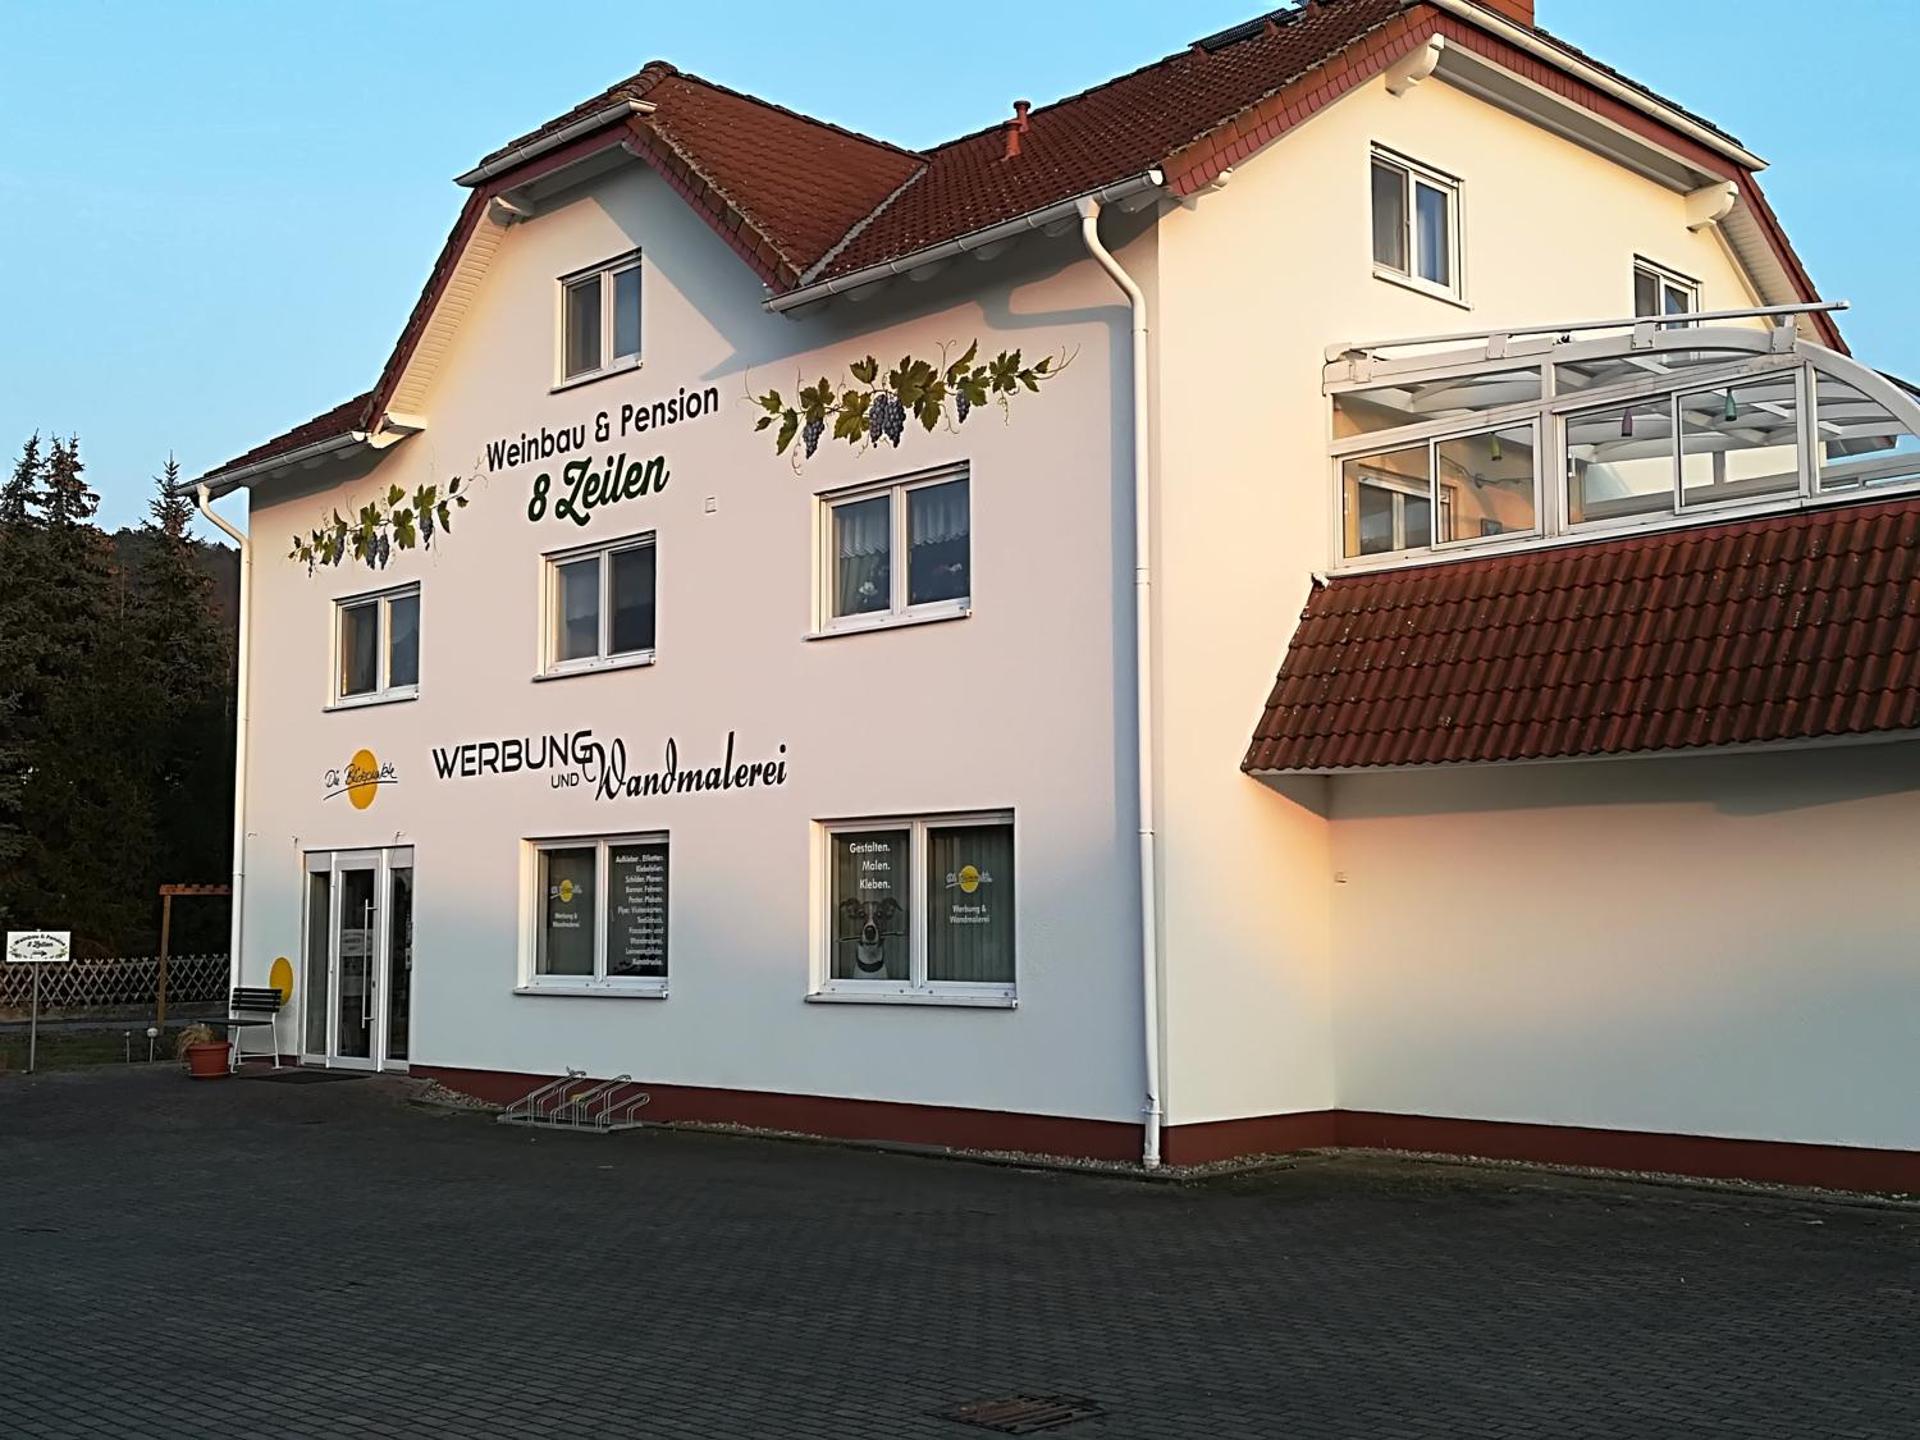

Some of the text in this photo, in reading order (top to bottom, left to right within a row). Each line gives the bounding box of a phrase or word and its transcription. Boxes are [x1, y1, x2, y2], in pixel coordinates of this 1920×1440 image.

[487, 386, 719, 472] Weinbau & Pension
[528, 453, 670, 527] 8 Zeilen
[432, 730, 787, 801] WERBUNG UND Wandmalerei
[850, 842, 890, 853] Gestalten.
[862, 861, 891, 871] Malen.
[860, 879, 891, 889] Kleben.
